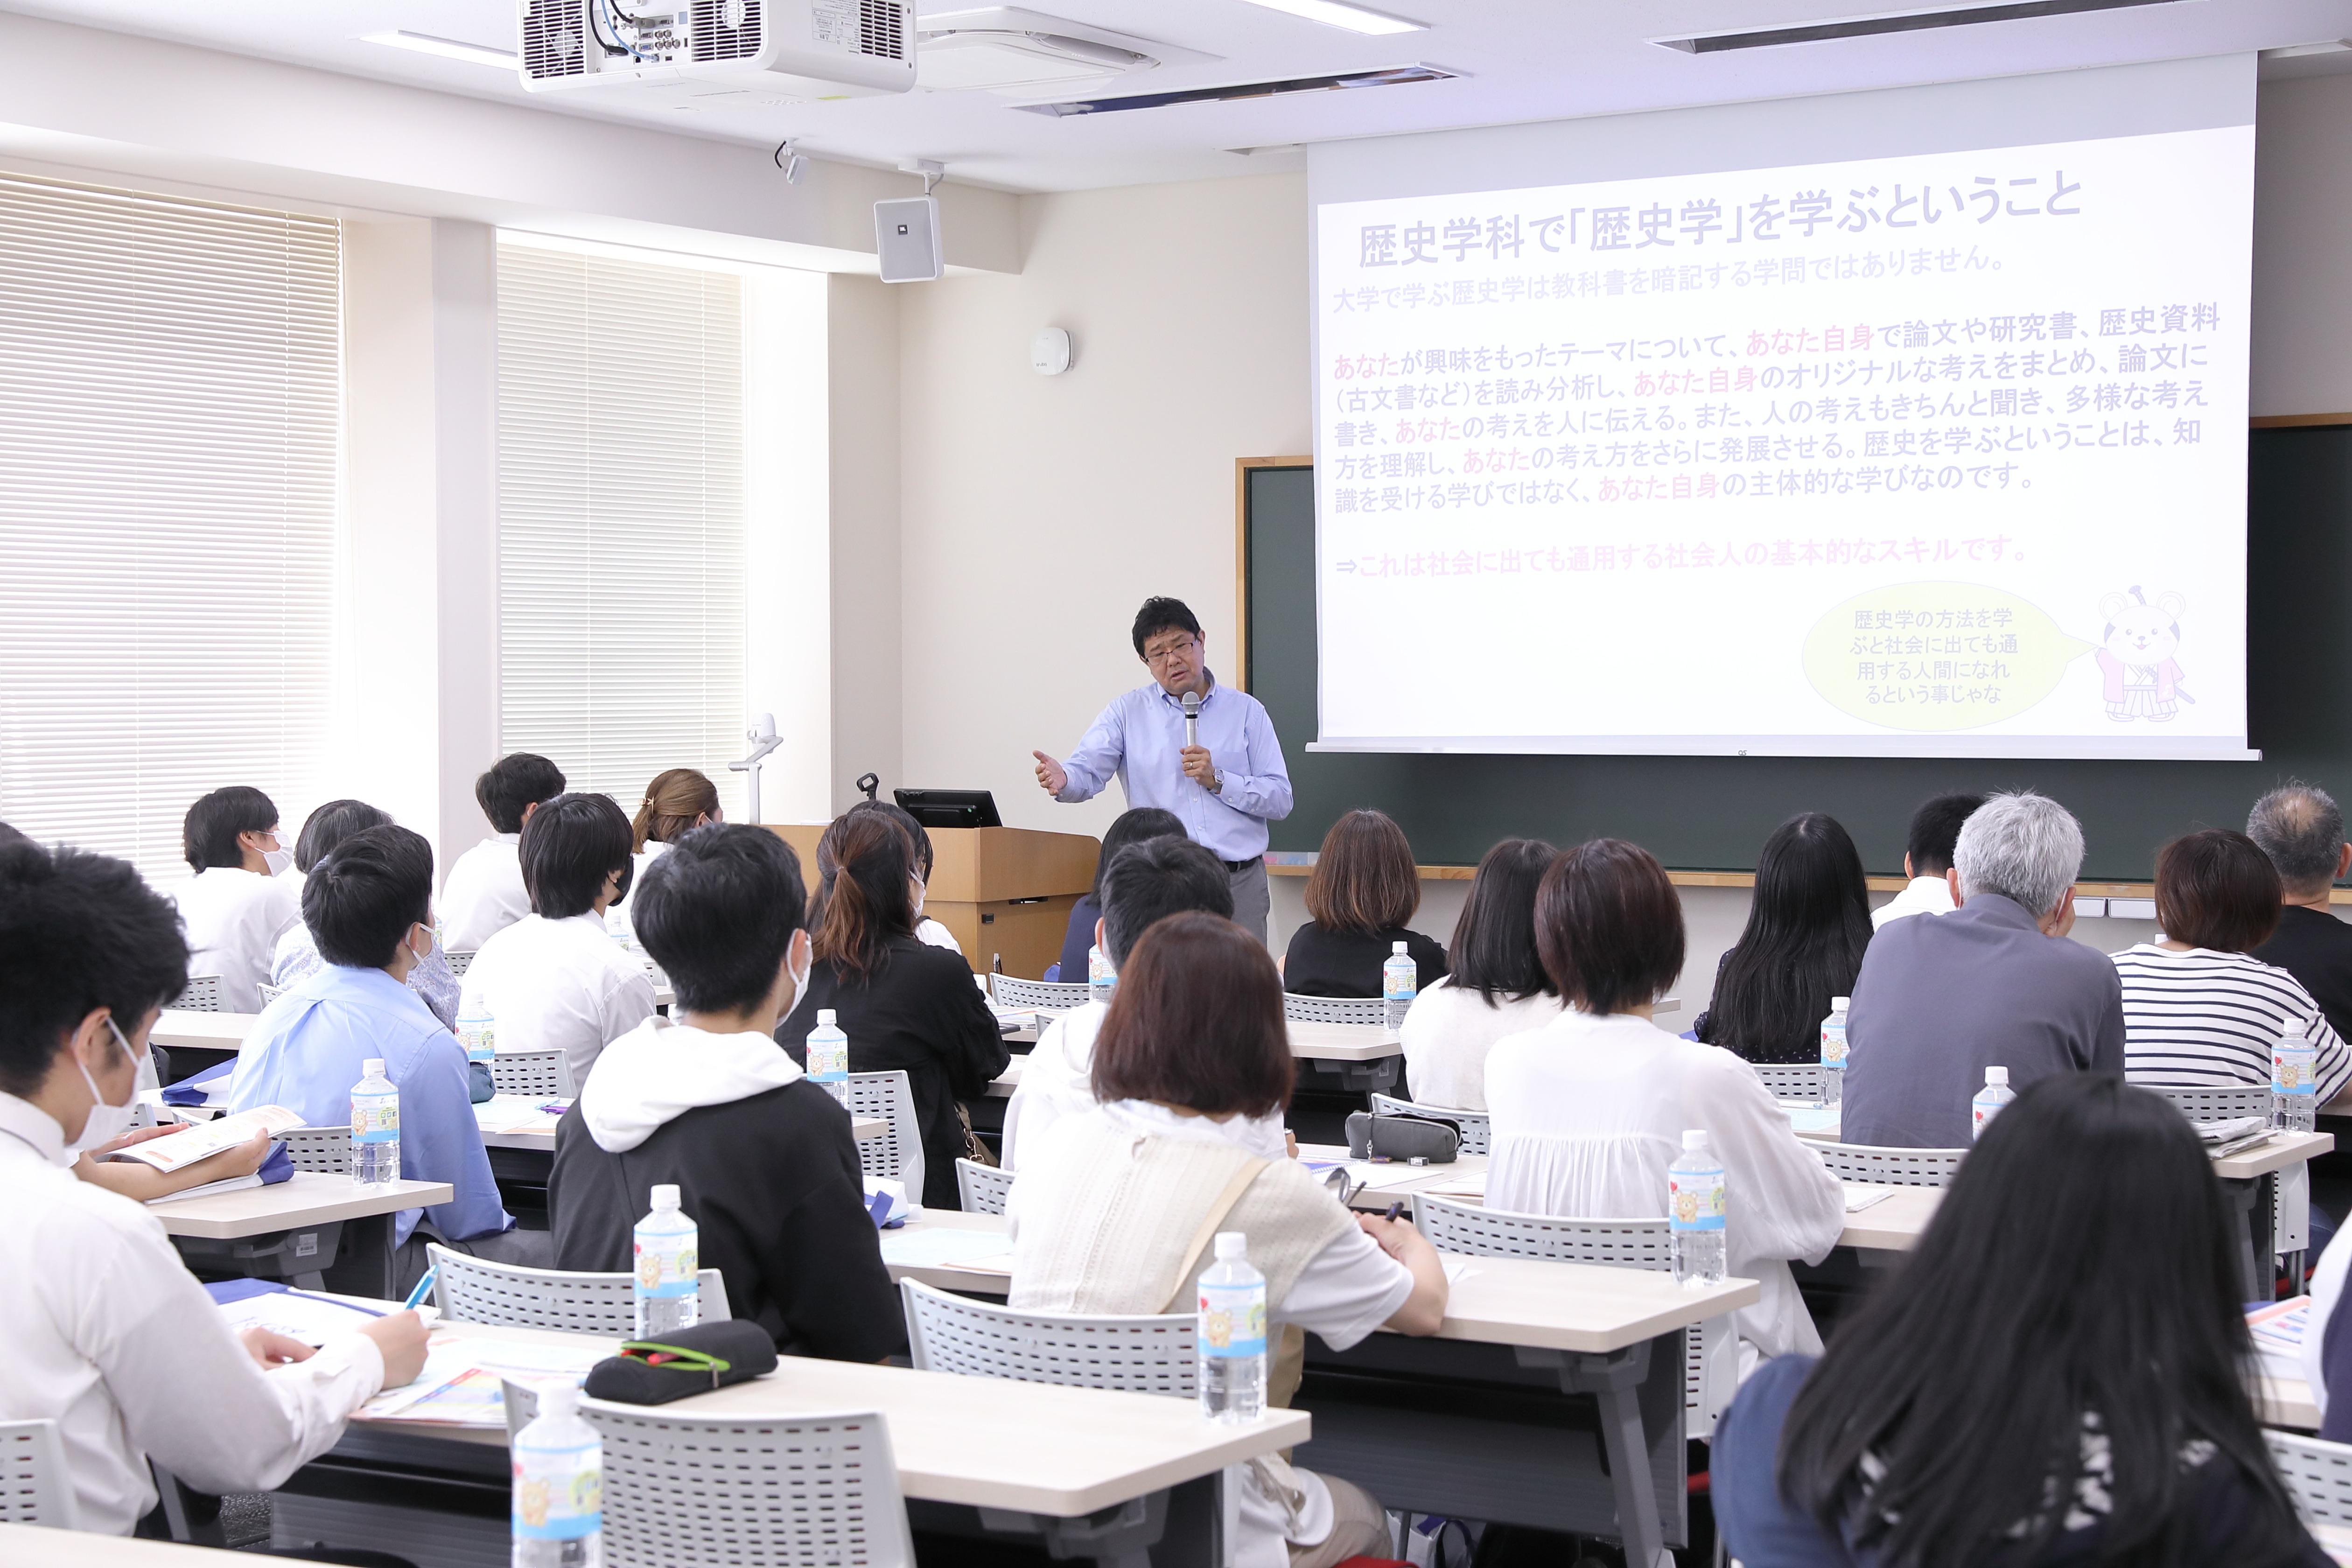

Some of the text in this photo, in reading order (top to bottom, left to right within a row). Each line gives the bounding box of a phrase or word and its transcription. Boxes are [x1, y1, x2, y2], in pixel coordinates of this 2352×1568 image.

[1359, 170, 2082, 269] 歴史学科で「歴史学」を学ぶということ
[1333, 245, 2002, 313] 大学で学ぶ歴史学は教科書を暗記する学問ではありません。
[1855, 608, 2012, 630] 歴史学の方法を学
[1849, 635, 2018, 655] ぶと社会に出ても通
[1857, 660, 2010, 681] 用する人間になれ
[1865, 685, 2002, 705] るという事じゃな
